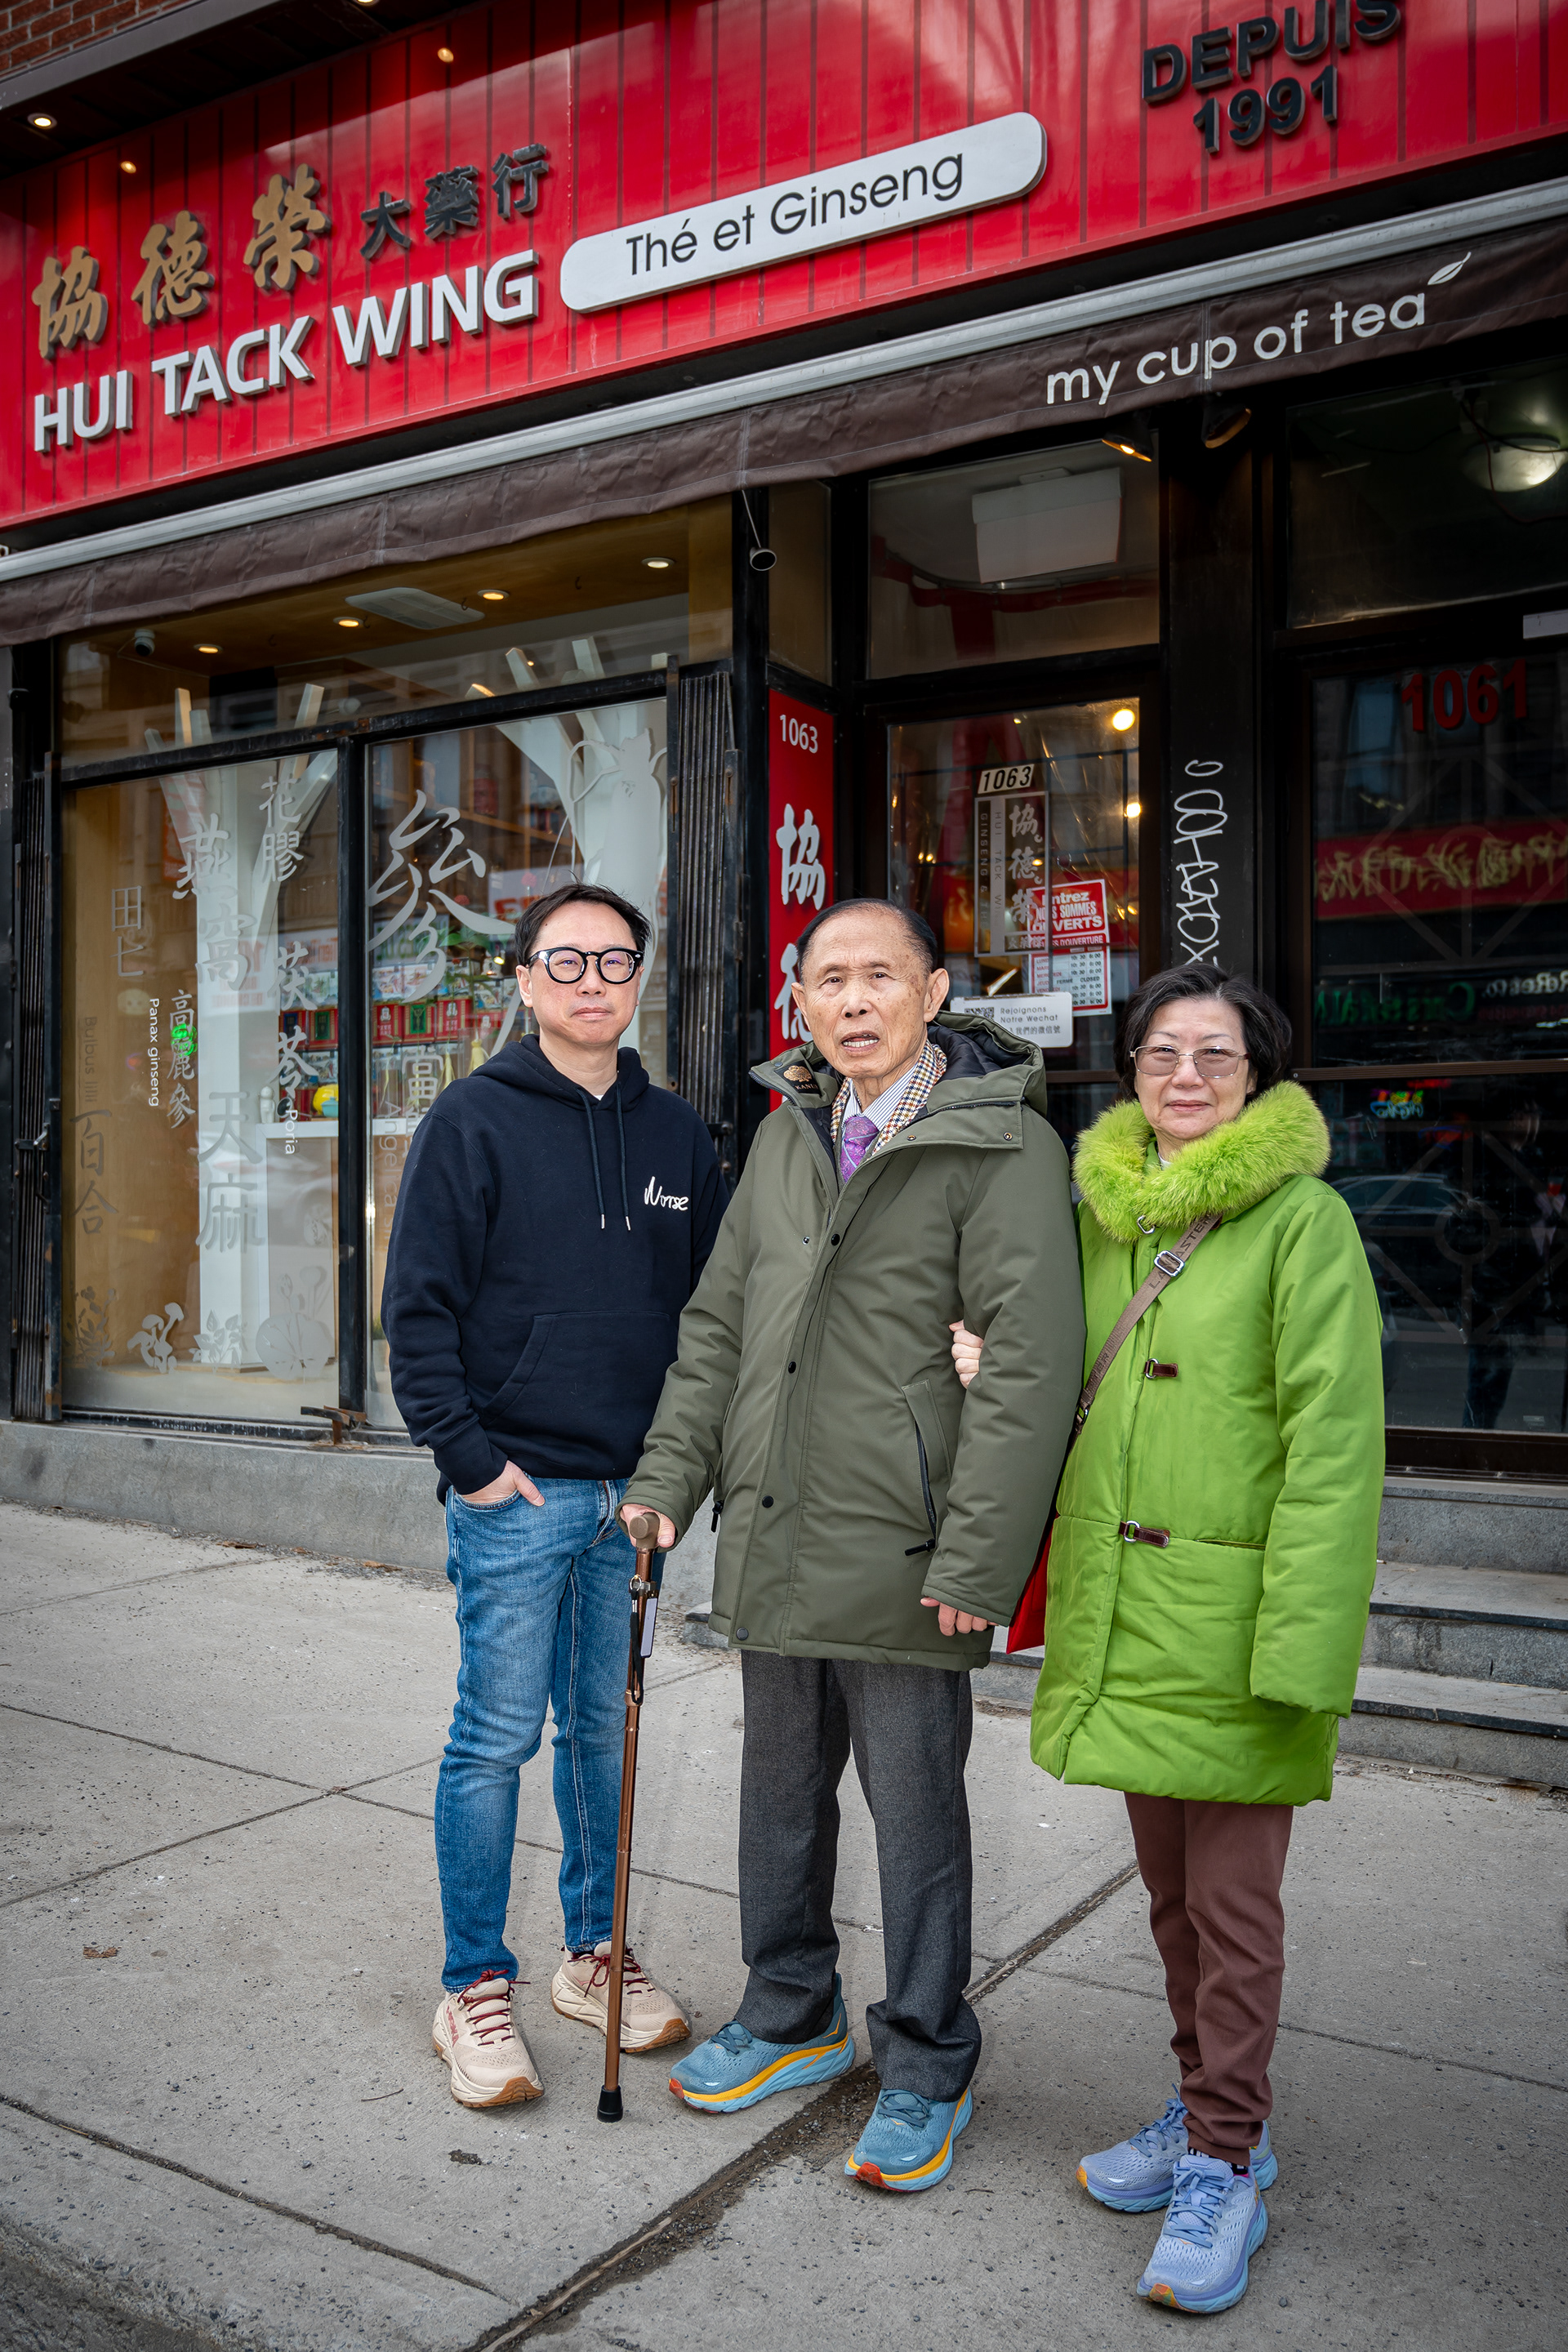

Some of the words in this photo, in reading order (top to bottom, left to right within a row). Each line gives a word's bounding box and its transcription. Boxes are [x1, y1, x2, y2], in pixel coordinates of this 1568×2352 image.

[1143, 0, 1401, 104] DEPUIS
[1192, 65, 1338, 154] 1991
[626, 218, 698, 275] Thé
[713, 205, 755, 252] et
[770, 154, 963, 234] Ginseng
[32, 164, 331, 359] 協德榮
[360, 143, 549, 261] 大藥行
[34, 370, 132, 452] HUI
[152, 315, 314, 416] TACK
[332, 249, 538, 367] WING
[1047, 361, 1120, 405] my
[1137, 335, 1237, 385] cup
[1254, 309, 1308, 359] of
[1330, 292, 1425, 344] tea
[1401, 658, 1527, 732] 1061
[780, 714, 818, 754] 1063
[982, 765, 1032, 792] 1063
[980, 813, 988, 876] GINSENG
[994, 811, 1002, 835] HUI
[994, 849, 1002, 880] TACK
[110, 885, 144, 977] 田七
[1060, 902, 1097, 918] SOMMES
[149, 998, 160, 1043] Panax
[1000, 1006, 1046, 1014] Rejoignons
[147, 1047, 161, 1107] ginseng
[284, 1109, 298, 1155] Poria
[380, 1101, 402, 1207] Angelica
[196, 1091, 265, 1253] 天麻
